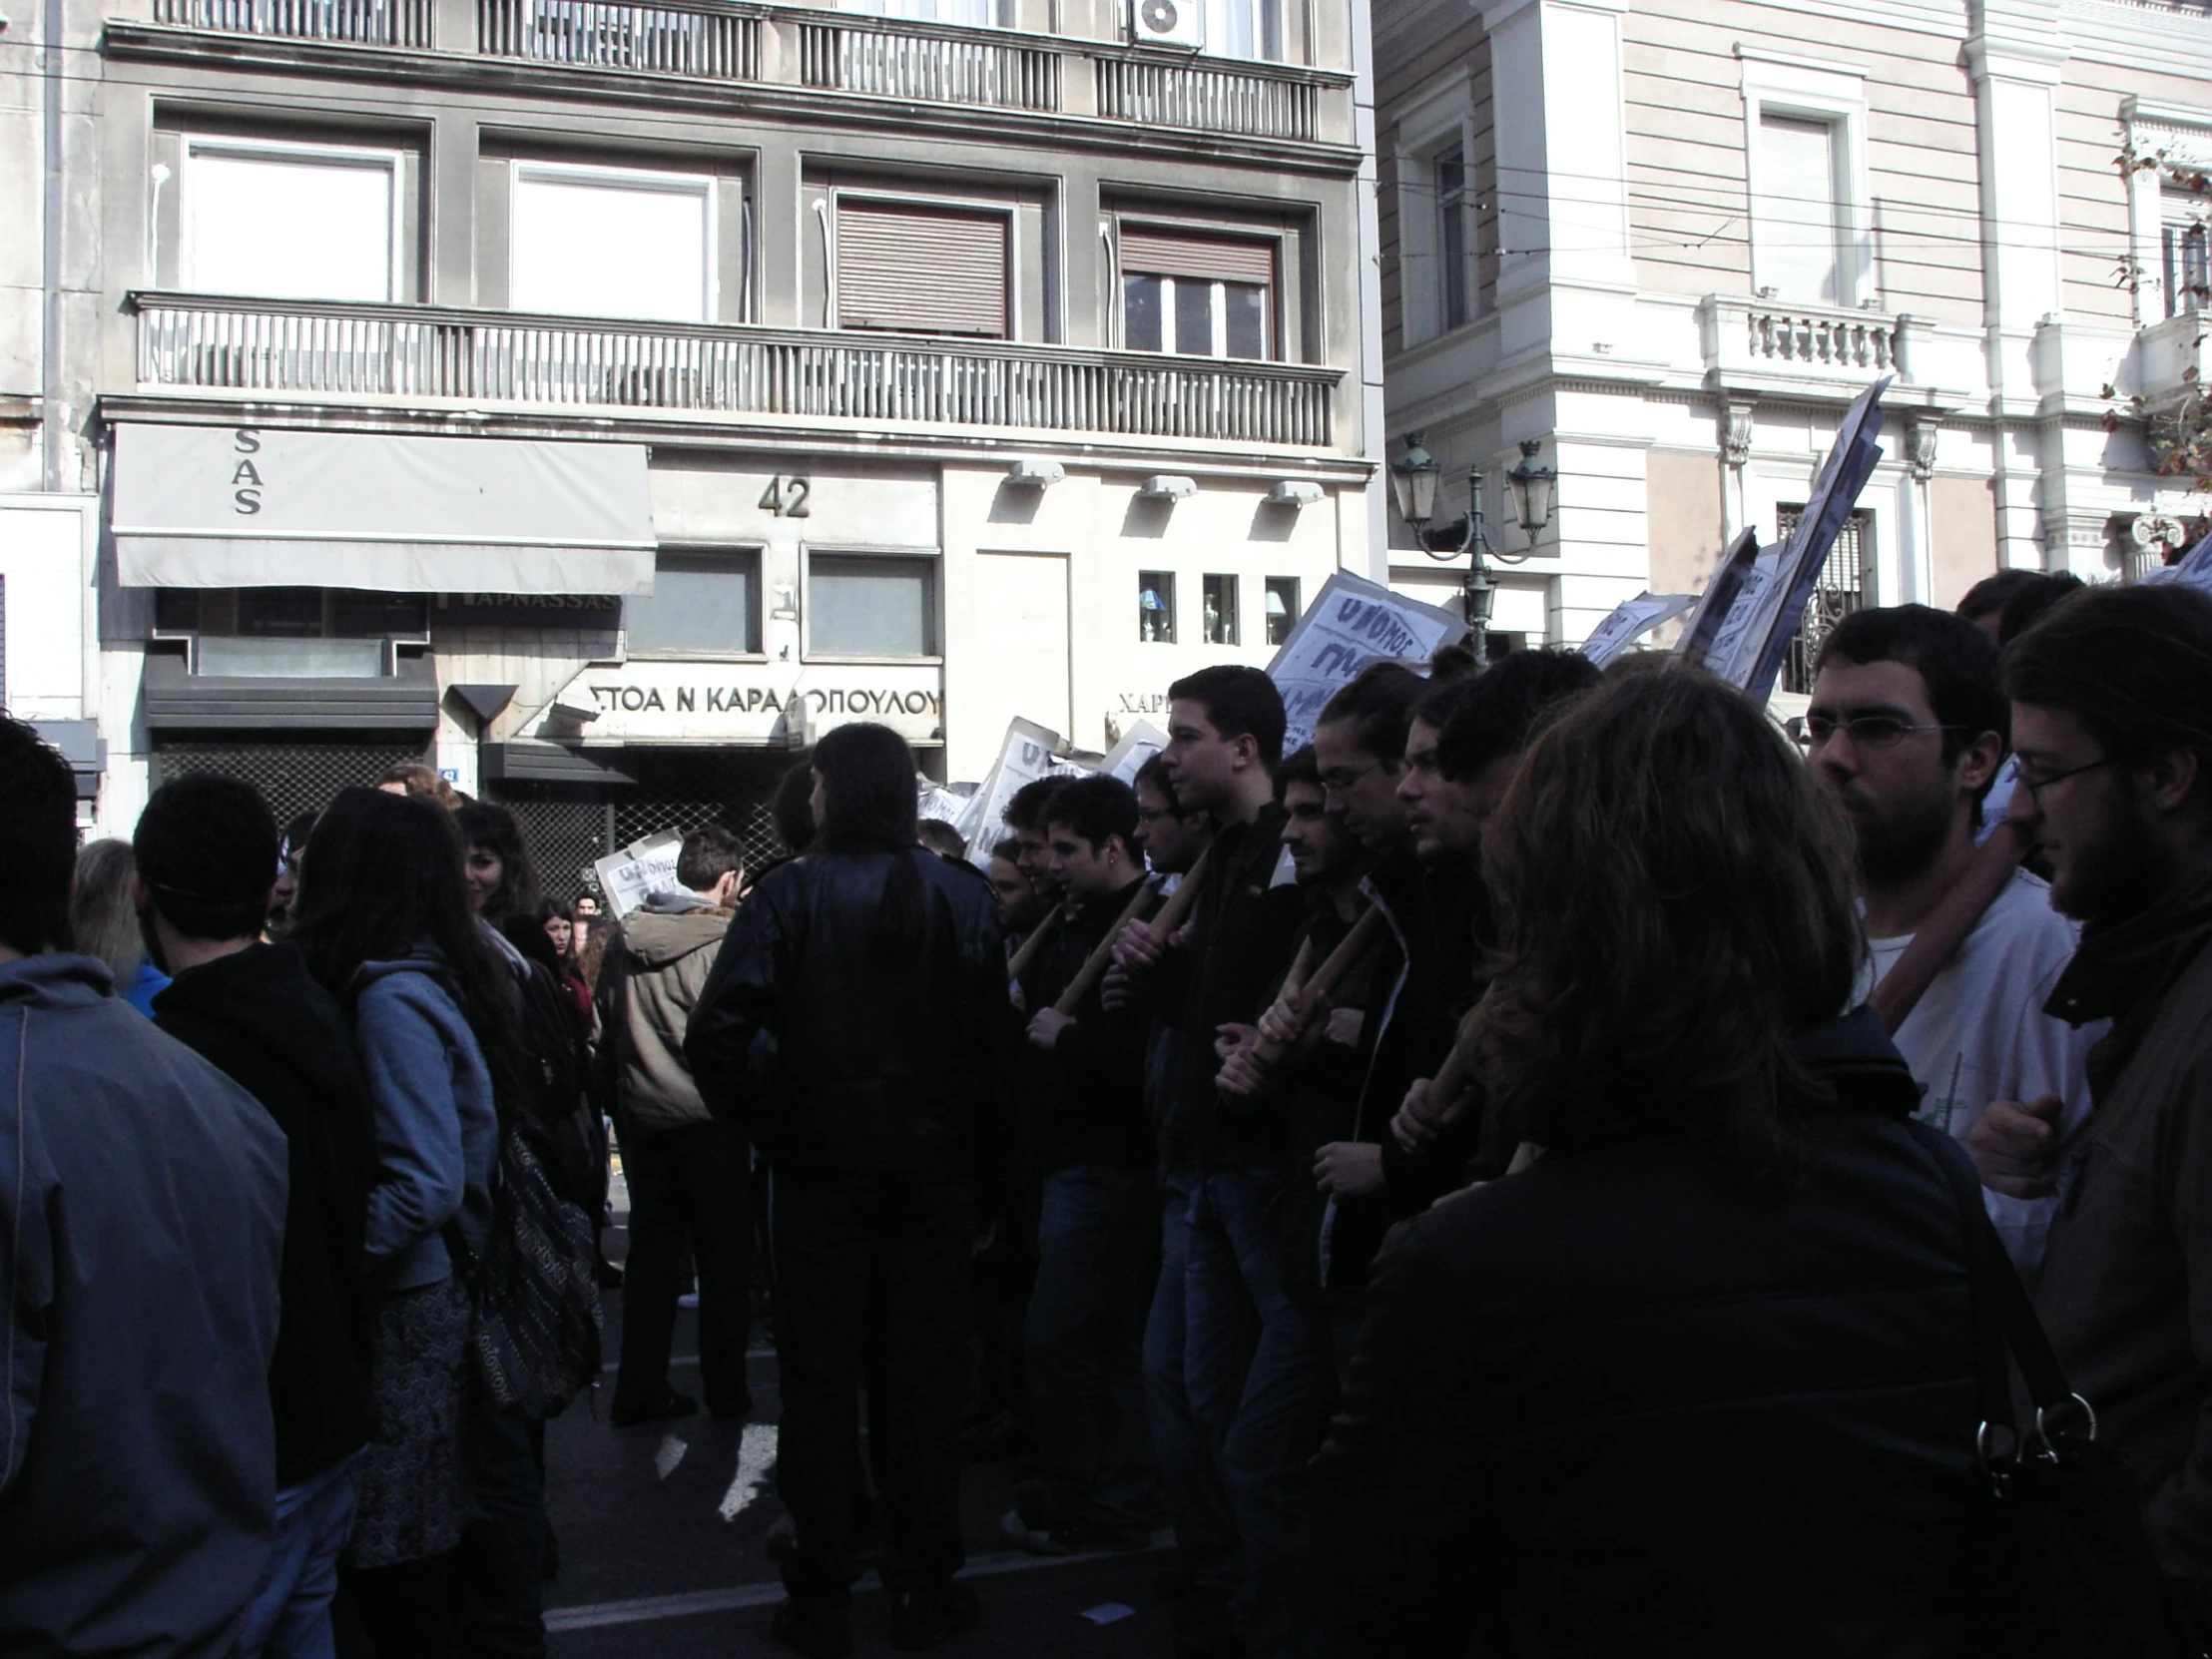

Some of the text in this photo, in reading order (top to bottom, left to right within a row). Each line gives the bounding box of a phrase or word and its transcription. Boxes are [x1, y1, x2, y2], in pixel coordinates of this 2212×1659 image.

[232, 429, 264, 514] SAS
[759, 476, 810, 517] 42
[589, 686, 666, 712] ΣΤΟΑ
[677, 687, 695, 712] Ν
